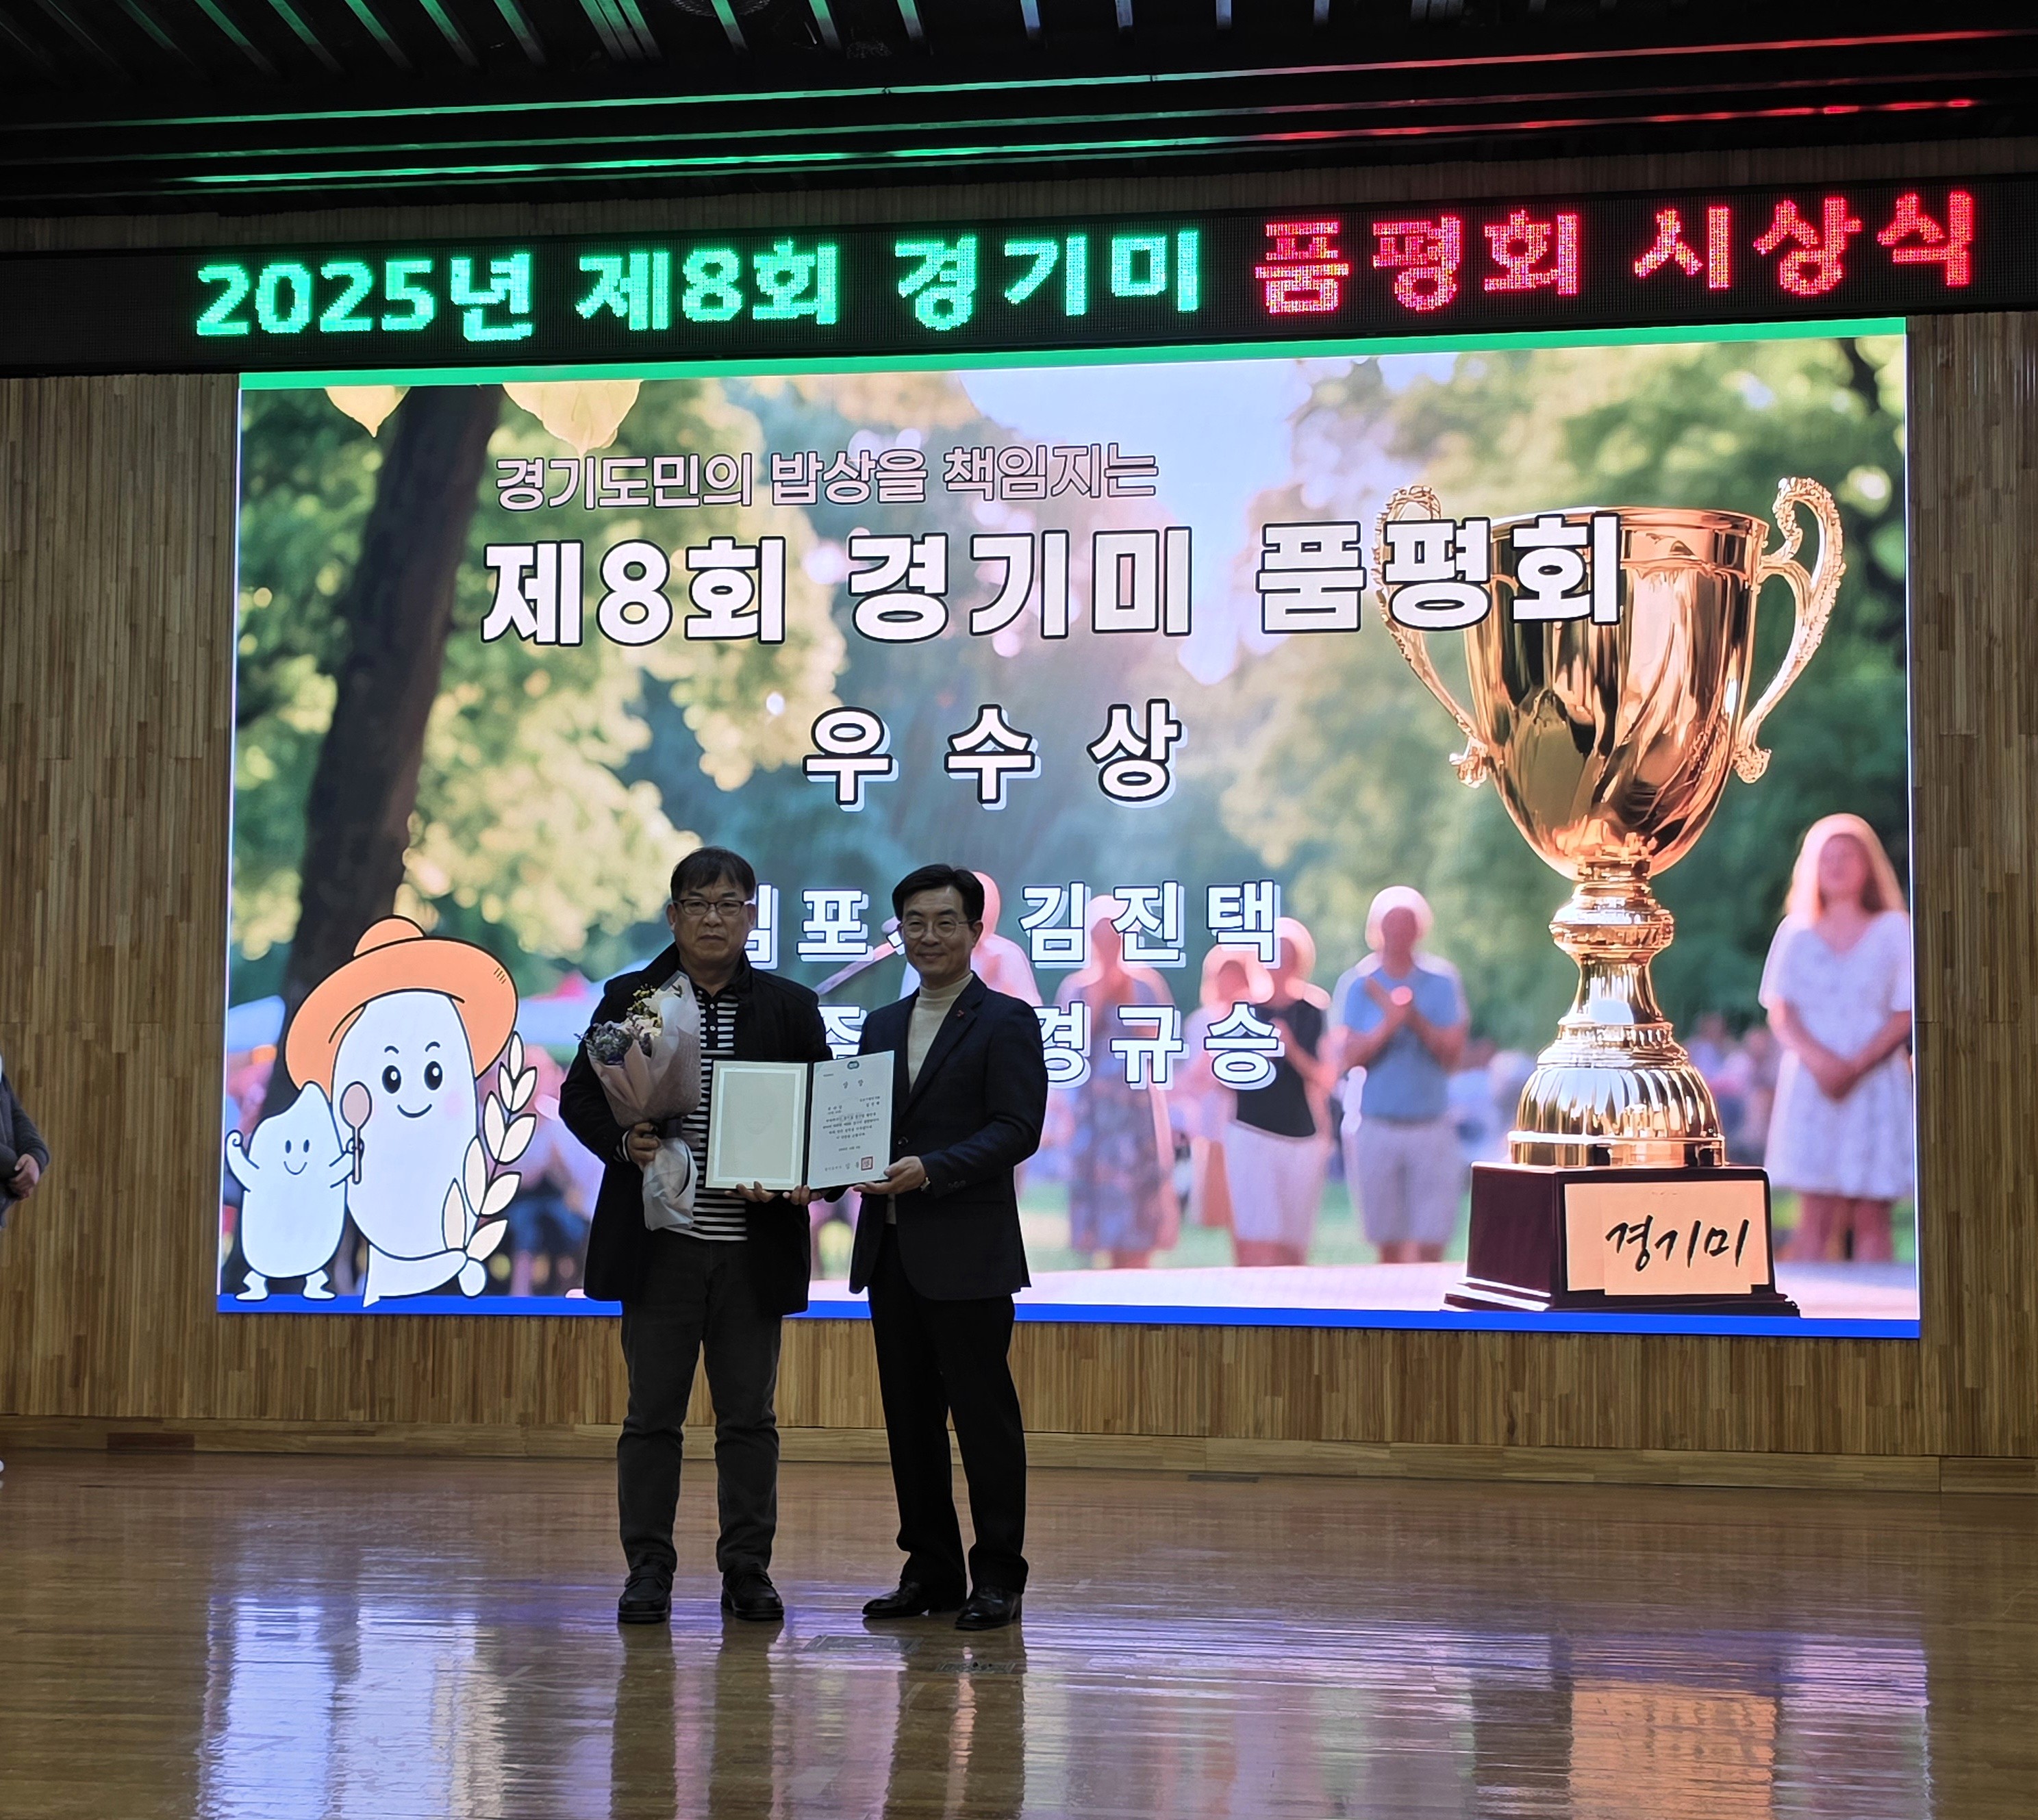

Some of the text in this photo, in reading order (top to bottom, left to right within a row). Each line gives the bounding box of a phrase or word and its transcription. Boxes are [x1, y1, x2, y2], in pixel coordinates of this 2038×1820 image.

[195, 191, 1973, 342] 2025년 제8회 경기미 품평회 시상식
[496, 443, 1159, 510] 경기도민의 밥상을 책임지는
[481, 515, 1620, 646] 제8회 경기미 품평회
[1605, 1215, 1750, 1272] 경기미
